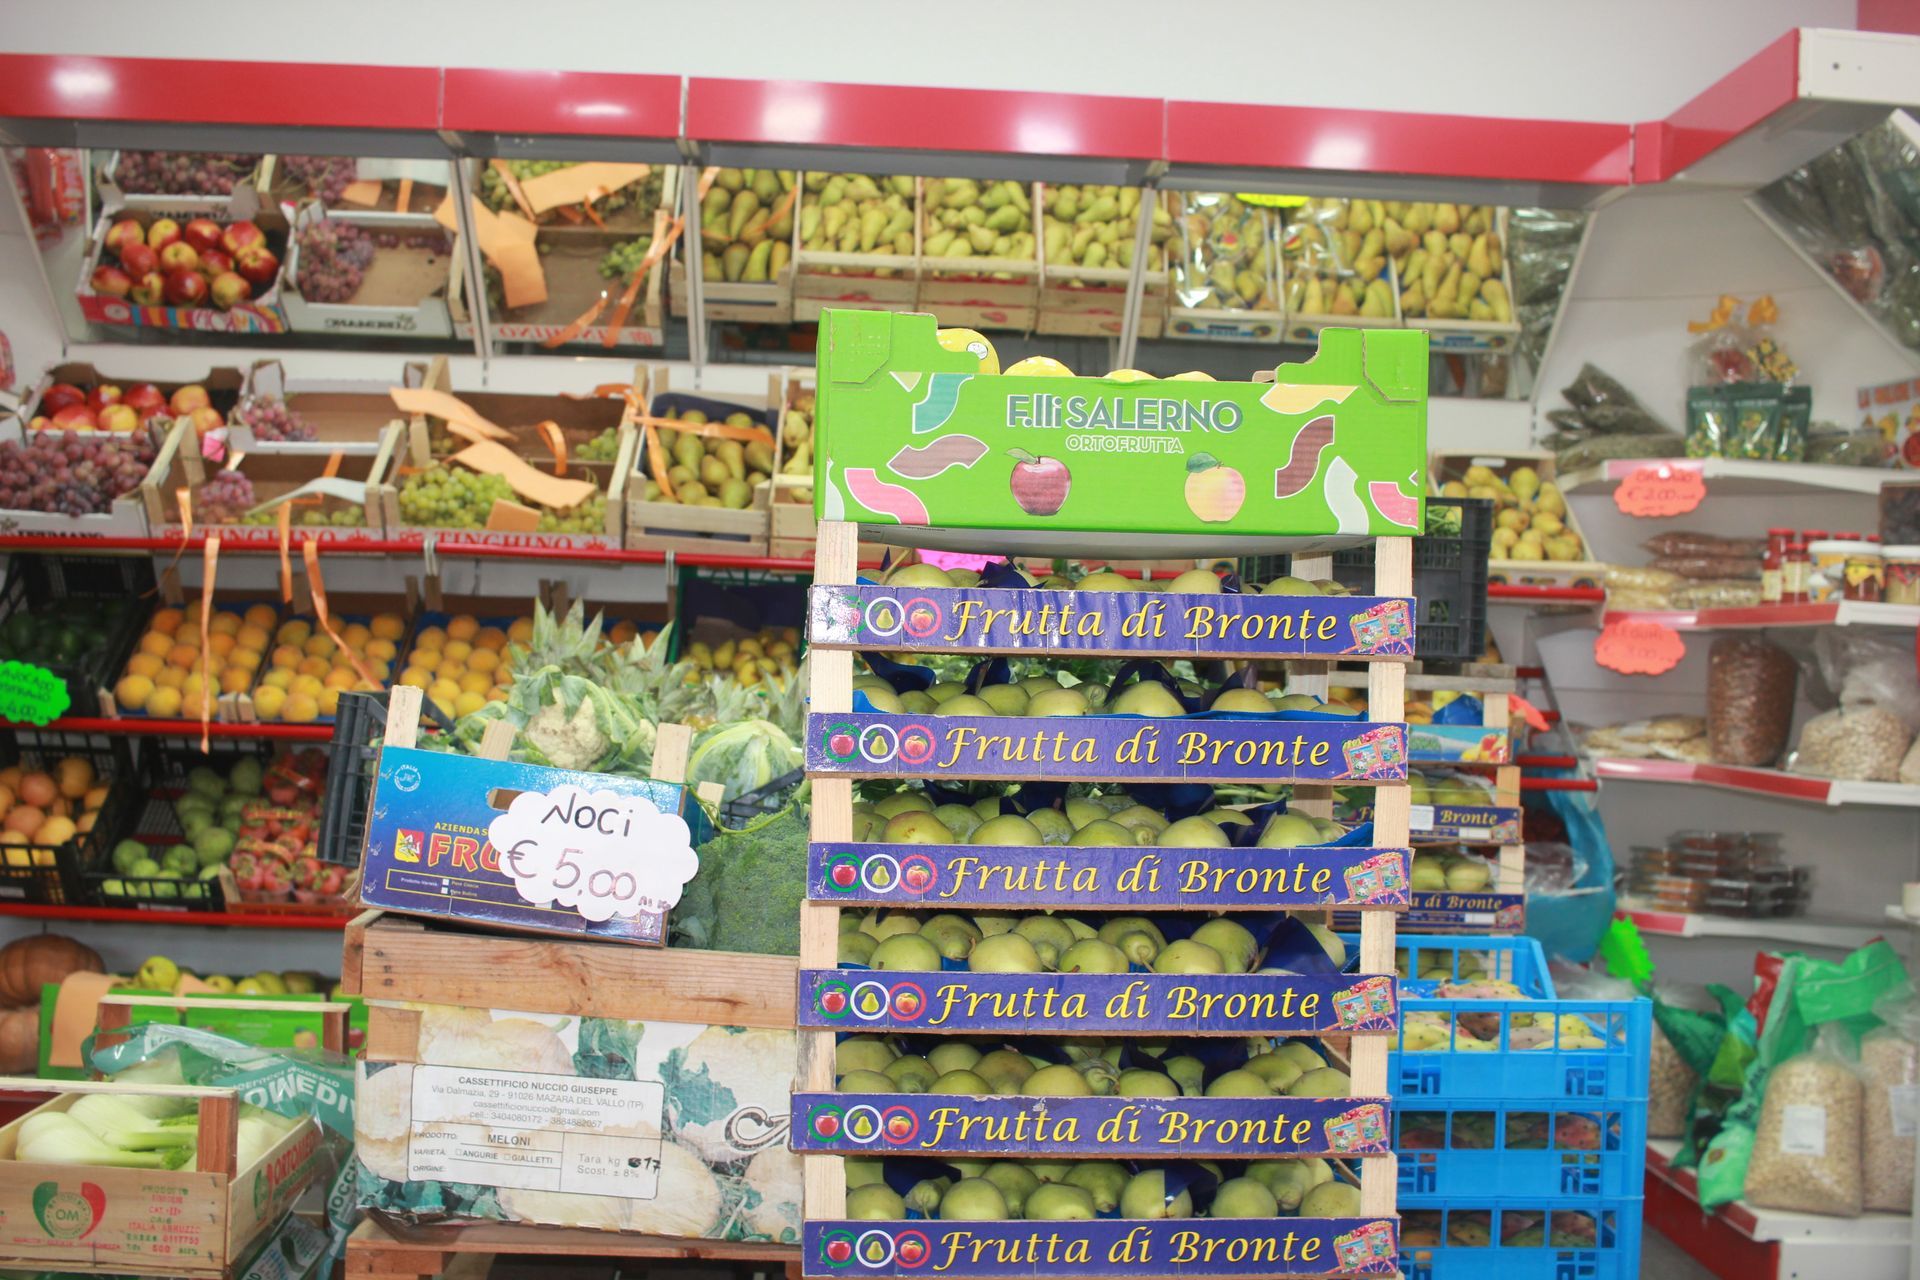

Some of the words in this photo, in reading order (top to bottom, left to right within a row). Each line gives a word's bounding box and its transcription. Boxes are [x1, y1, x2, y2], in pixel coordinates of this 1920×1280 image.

[1006, 393, 1063, 428] F.lli
[1065, 396, 1243, 433] SALERNO
[1065, 434, 1184, 454] ORTOFRUTTA
[944, 600, 1105, 642] Frutta
[1121, 601, 1167, 638] di
[1182, 608, 1338, 642] Bronte
[937, 726, 1098, 768] Frutta
[1115, 727, 1161, 764] di
[1177, 732, 1330, 766] Bronte
[1440, 809, 1498, 825] Bronte
[435, 821, 480, 836] AZIENDA
[507, 839, 538, 879] €
[939, 856, 1100, 898] Frutta
[1116, 856, 1162, 893] di
[1178, 859, 1331, 894] Bronte
[1447, 895, 1502, 910] Bronte
[928, 983, 1090, 1025] Frutta
[1105, 982, 1150, 1020] di
[1167, 987, 1319, 1020] Bronte
[458, 1076, 529, 1089] CASSETTIFICIO
[531, 1082, 569, 1092] NUCCIO
[571, 1084, 619, 1096] GIUSEPPE
[431, 1085, 445, 1094] Via
[489, 1090, 500, 1098] 29
[508, 1092, 534, 1100] 91026
[536, 1093, 575, 1104] MAZARA
[576, 1096, 594, 1106] DEL
[596, 1097, 625, 1108] VALLO
[627, 1100, 644, 1110] (TP)
[921, 1105, 1083, 1148] Frutta
[1097, 1105, 1144, 1142] di
[1157, 1108, 1311, 1144] Bronte
[487, 1134, 531, 1147] MELONI
[463, 1150, 499, 1160] ANGURIE
[511, 1154, 553, 1165] GIALLETTI
[578, 1153, 600, 1164] Tara
[608, 1156, 621, 1168] kg
[577, 1165, 608, 1176] Scost.
[934, 1229, 1094, 1270] Frutta
[1107, 1226, 1154, 1263] di
[1168, 1229, 1321, 1264] Bronte
